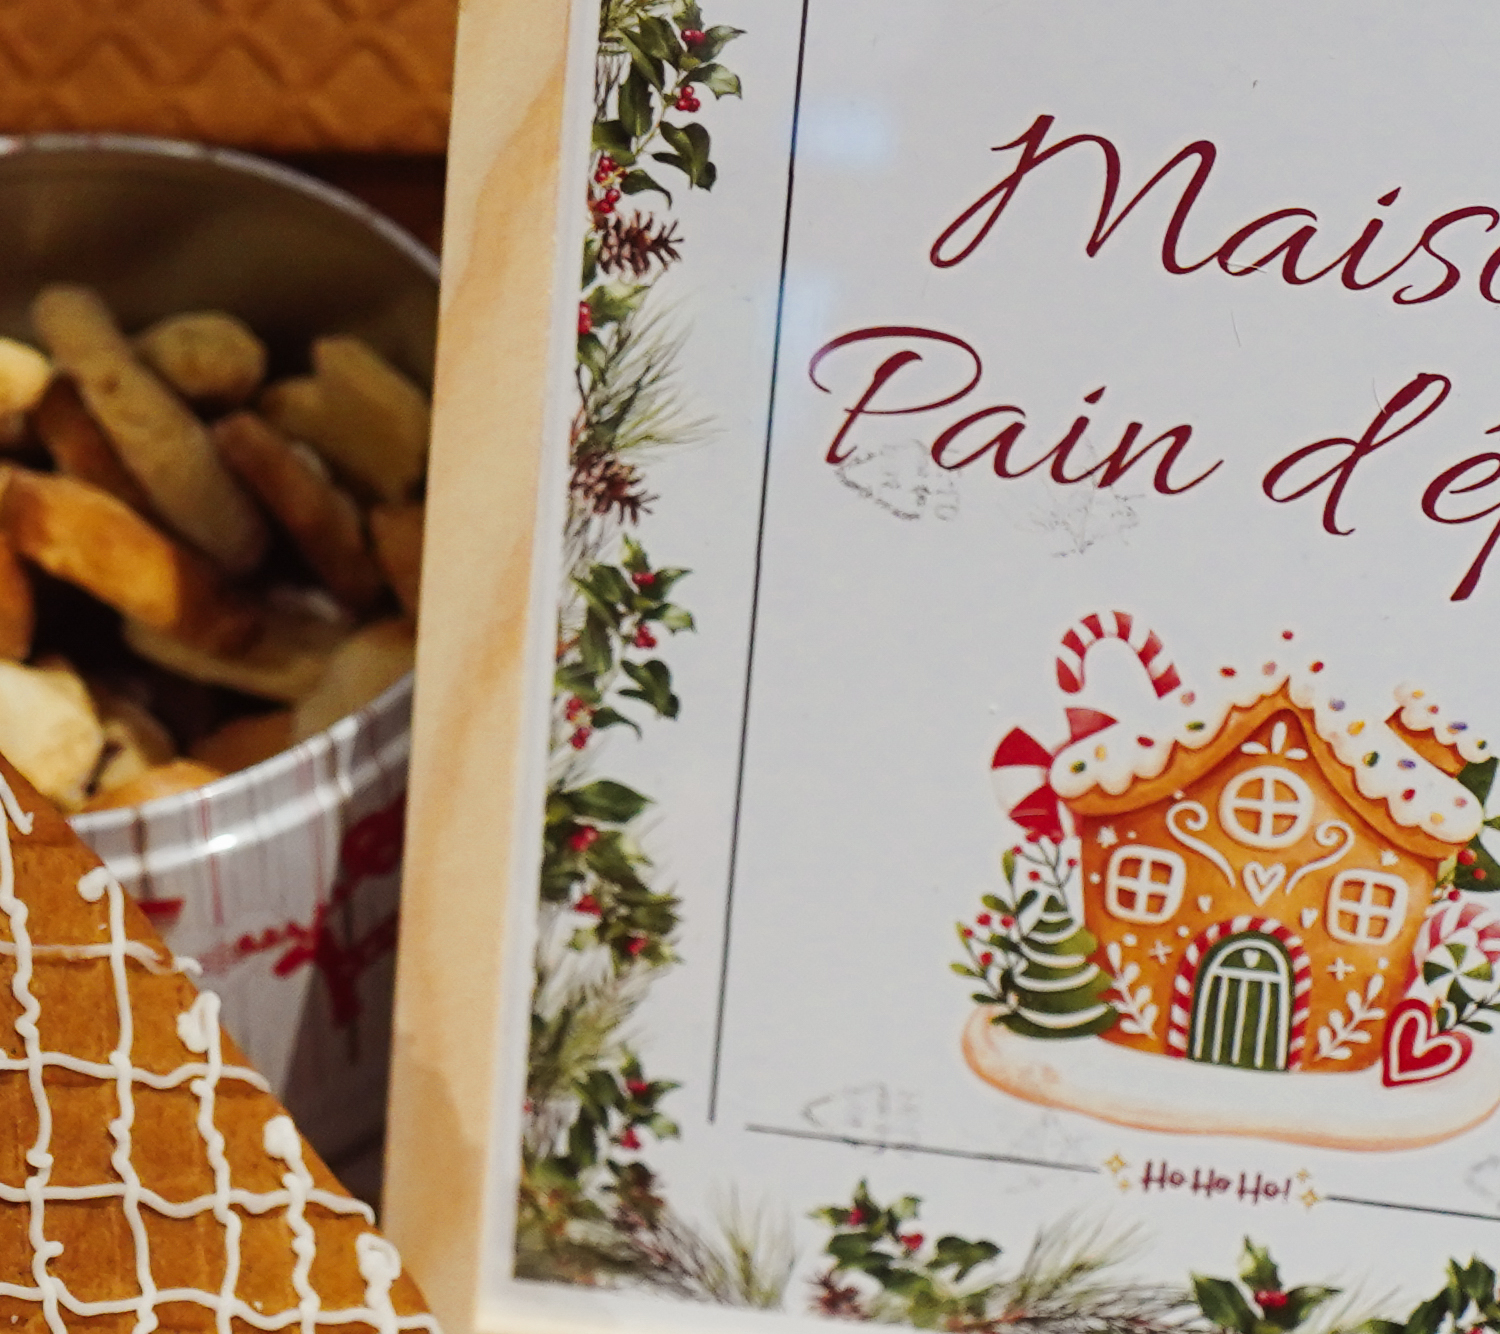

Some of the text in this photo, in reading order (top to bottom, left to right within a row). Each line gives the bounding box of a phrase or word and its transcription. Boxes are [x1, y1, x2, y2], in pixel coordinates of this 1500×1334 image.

[808, 324, 1223, 497] Pain
[1142, 1159, 1292, 1205] Ho Ho Ho!
